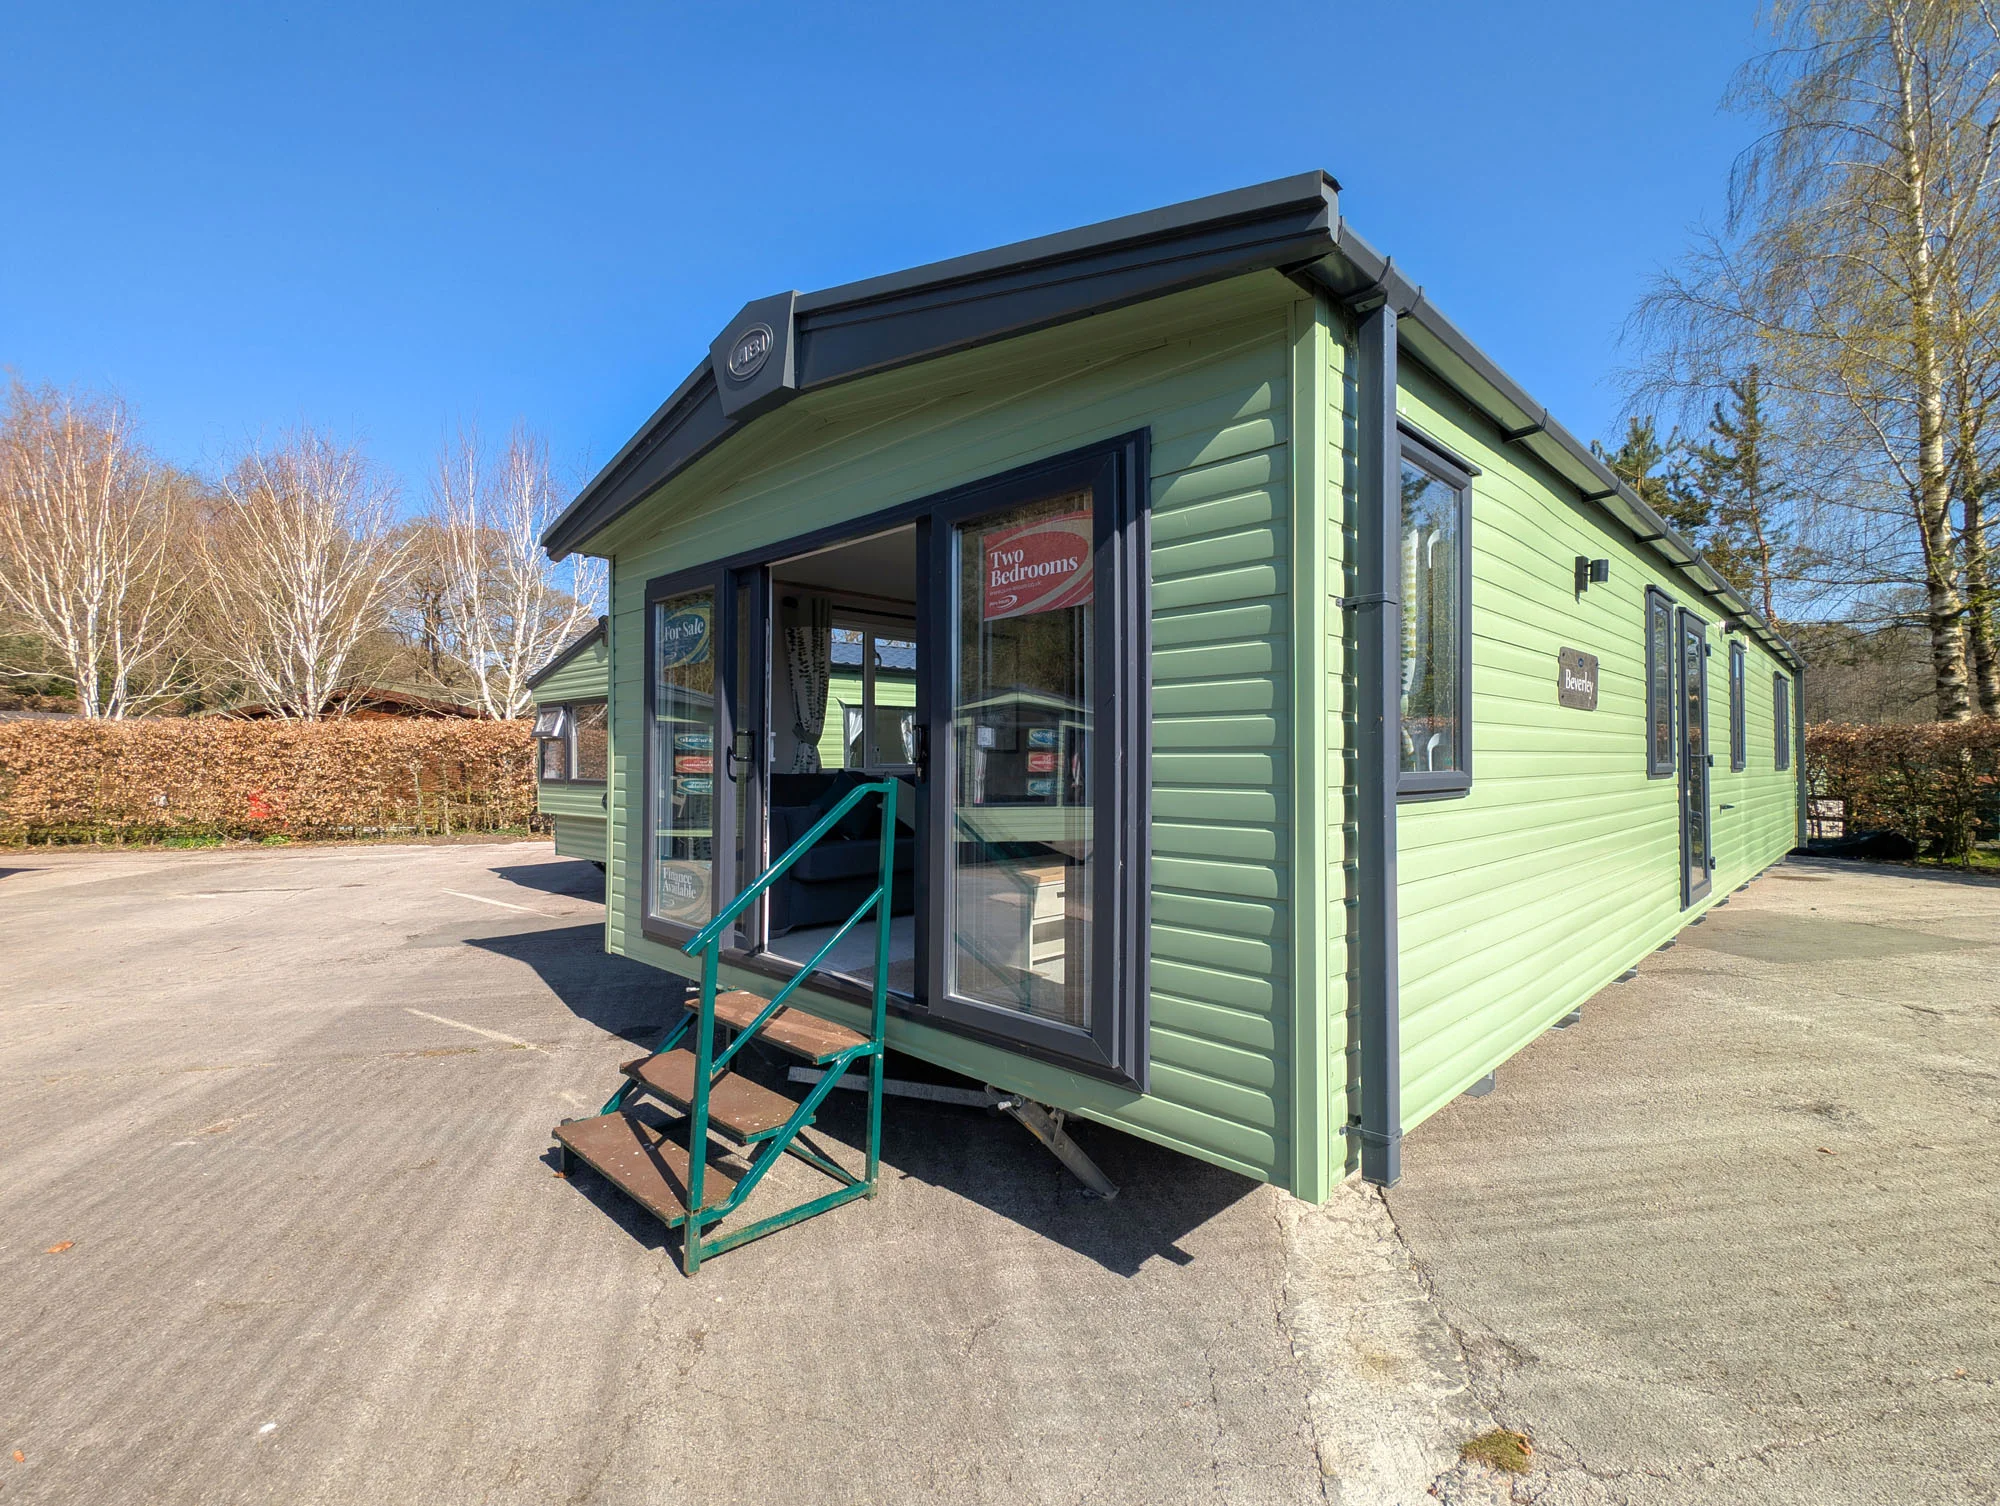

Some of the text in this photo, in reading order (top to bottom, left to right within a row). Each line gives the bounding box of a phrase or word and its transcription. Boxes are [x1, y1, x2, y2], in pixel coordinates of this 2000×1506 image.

[737, 334, 766, 364] ABI
[990, 549, 1024, 569] Two
[990, 556, 1079, 588] Bedrooms
[664, 618, 704, 641] For Sale
[1565, 668, 1594, 700] Beverley
[663, 867, 692, 885] Finance
[662, 879, 697, 899] Available
